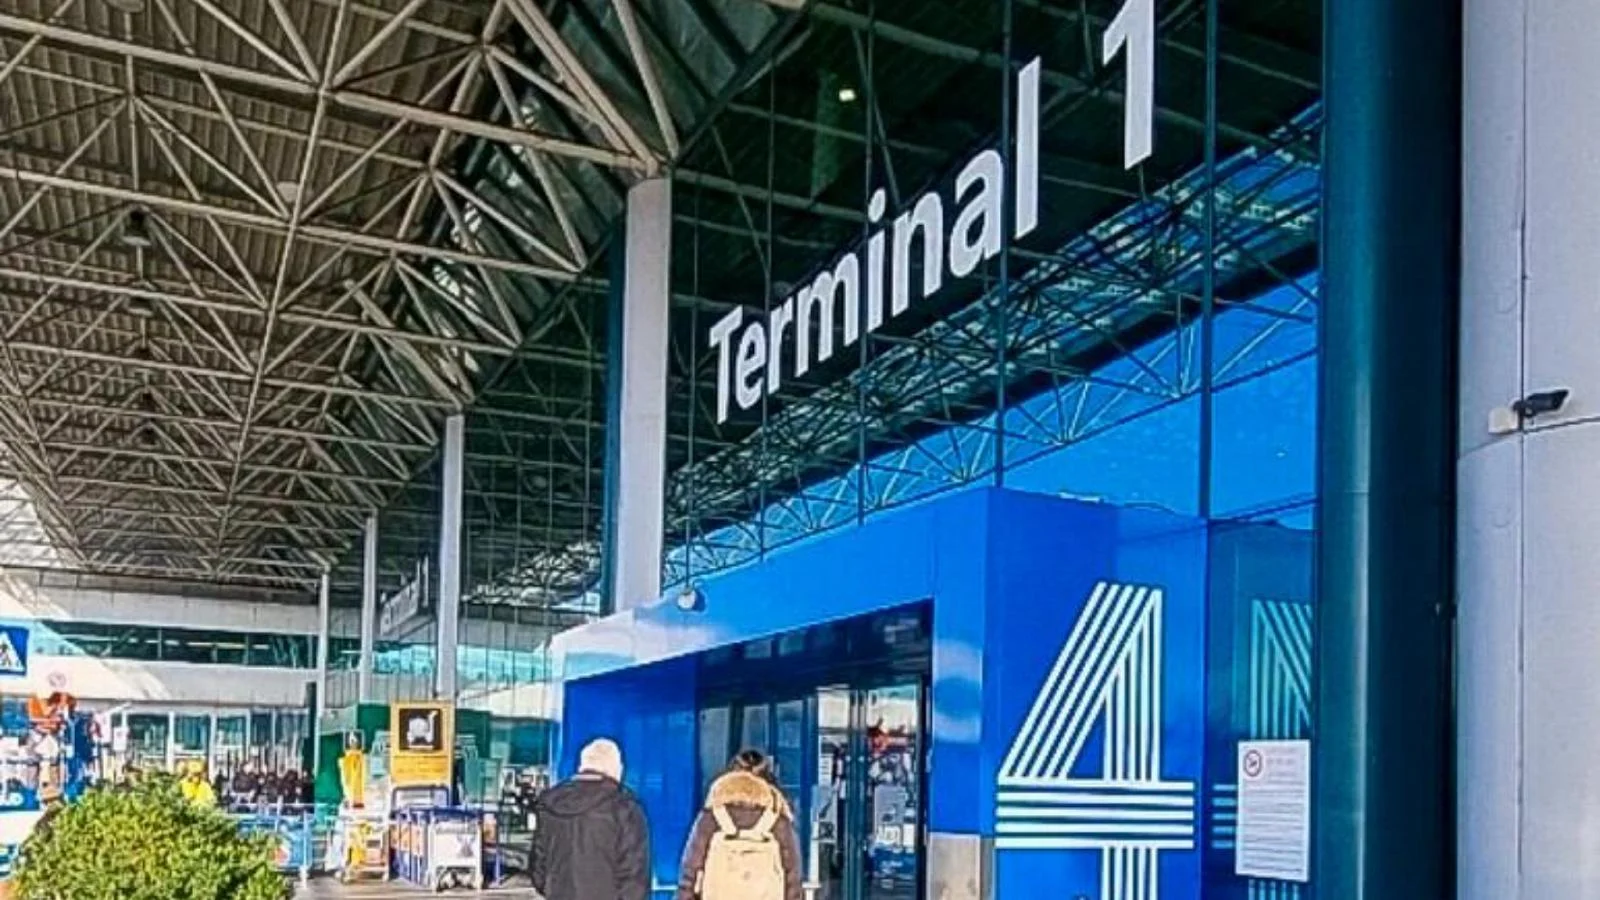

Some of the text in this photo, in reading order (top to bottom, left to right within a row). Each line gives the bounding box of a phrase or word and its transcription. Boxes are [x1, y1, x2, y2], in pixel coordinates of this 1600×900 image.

[710, 0, 1154, 424] Terminal 1
[995, 582, 1194, 900] 4
